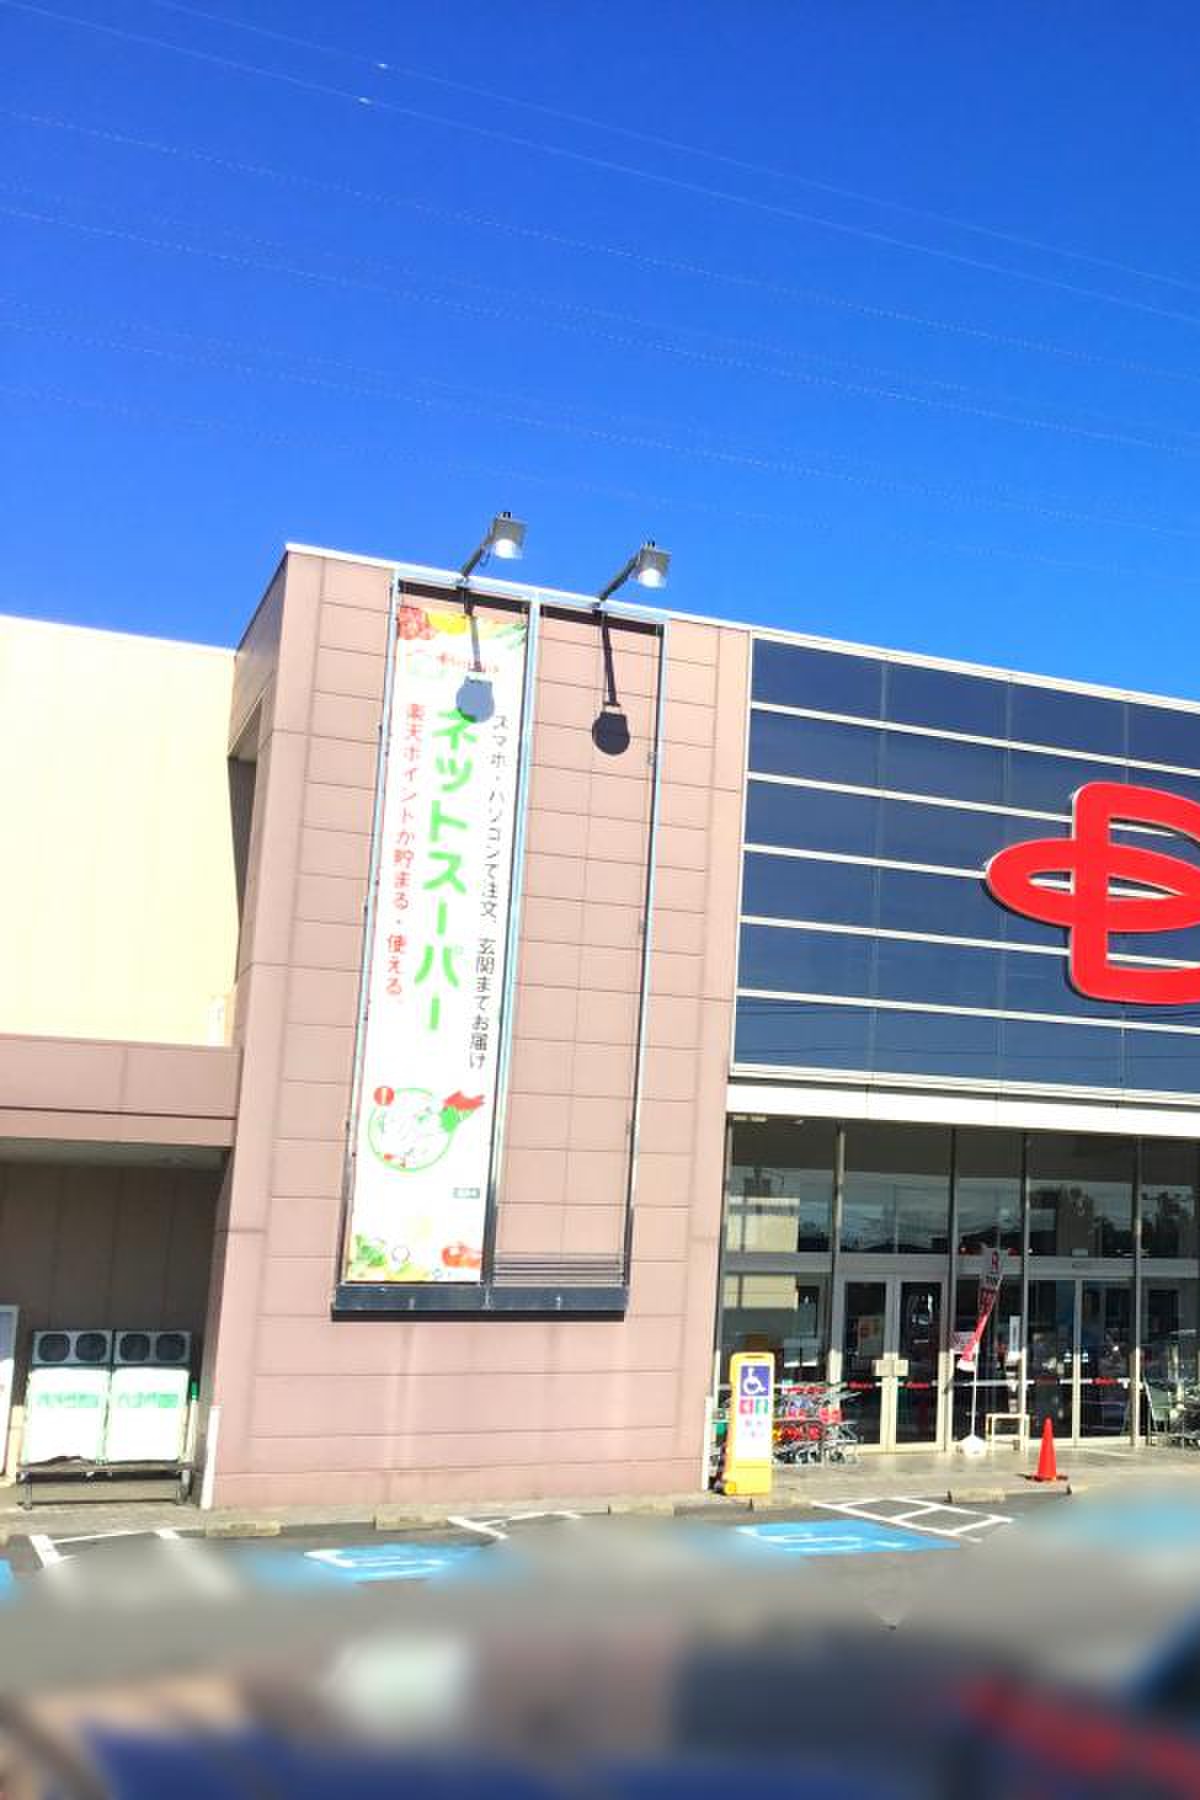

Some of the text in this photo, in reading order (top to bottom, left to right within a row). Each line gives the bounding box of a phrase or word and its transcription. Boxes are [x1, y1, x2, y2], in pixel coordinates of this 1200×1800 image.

[413, 706, 479, 1032] ネットスーパー
